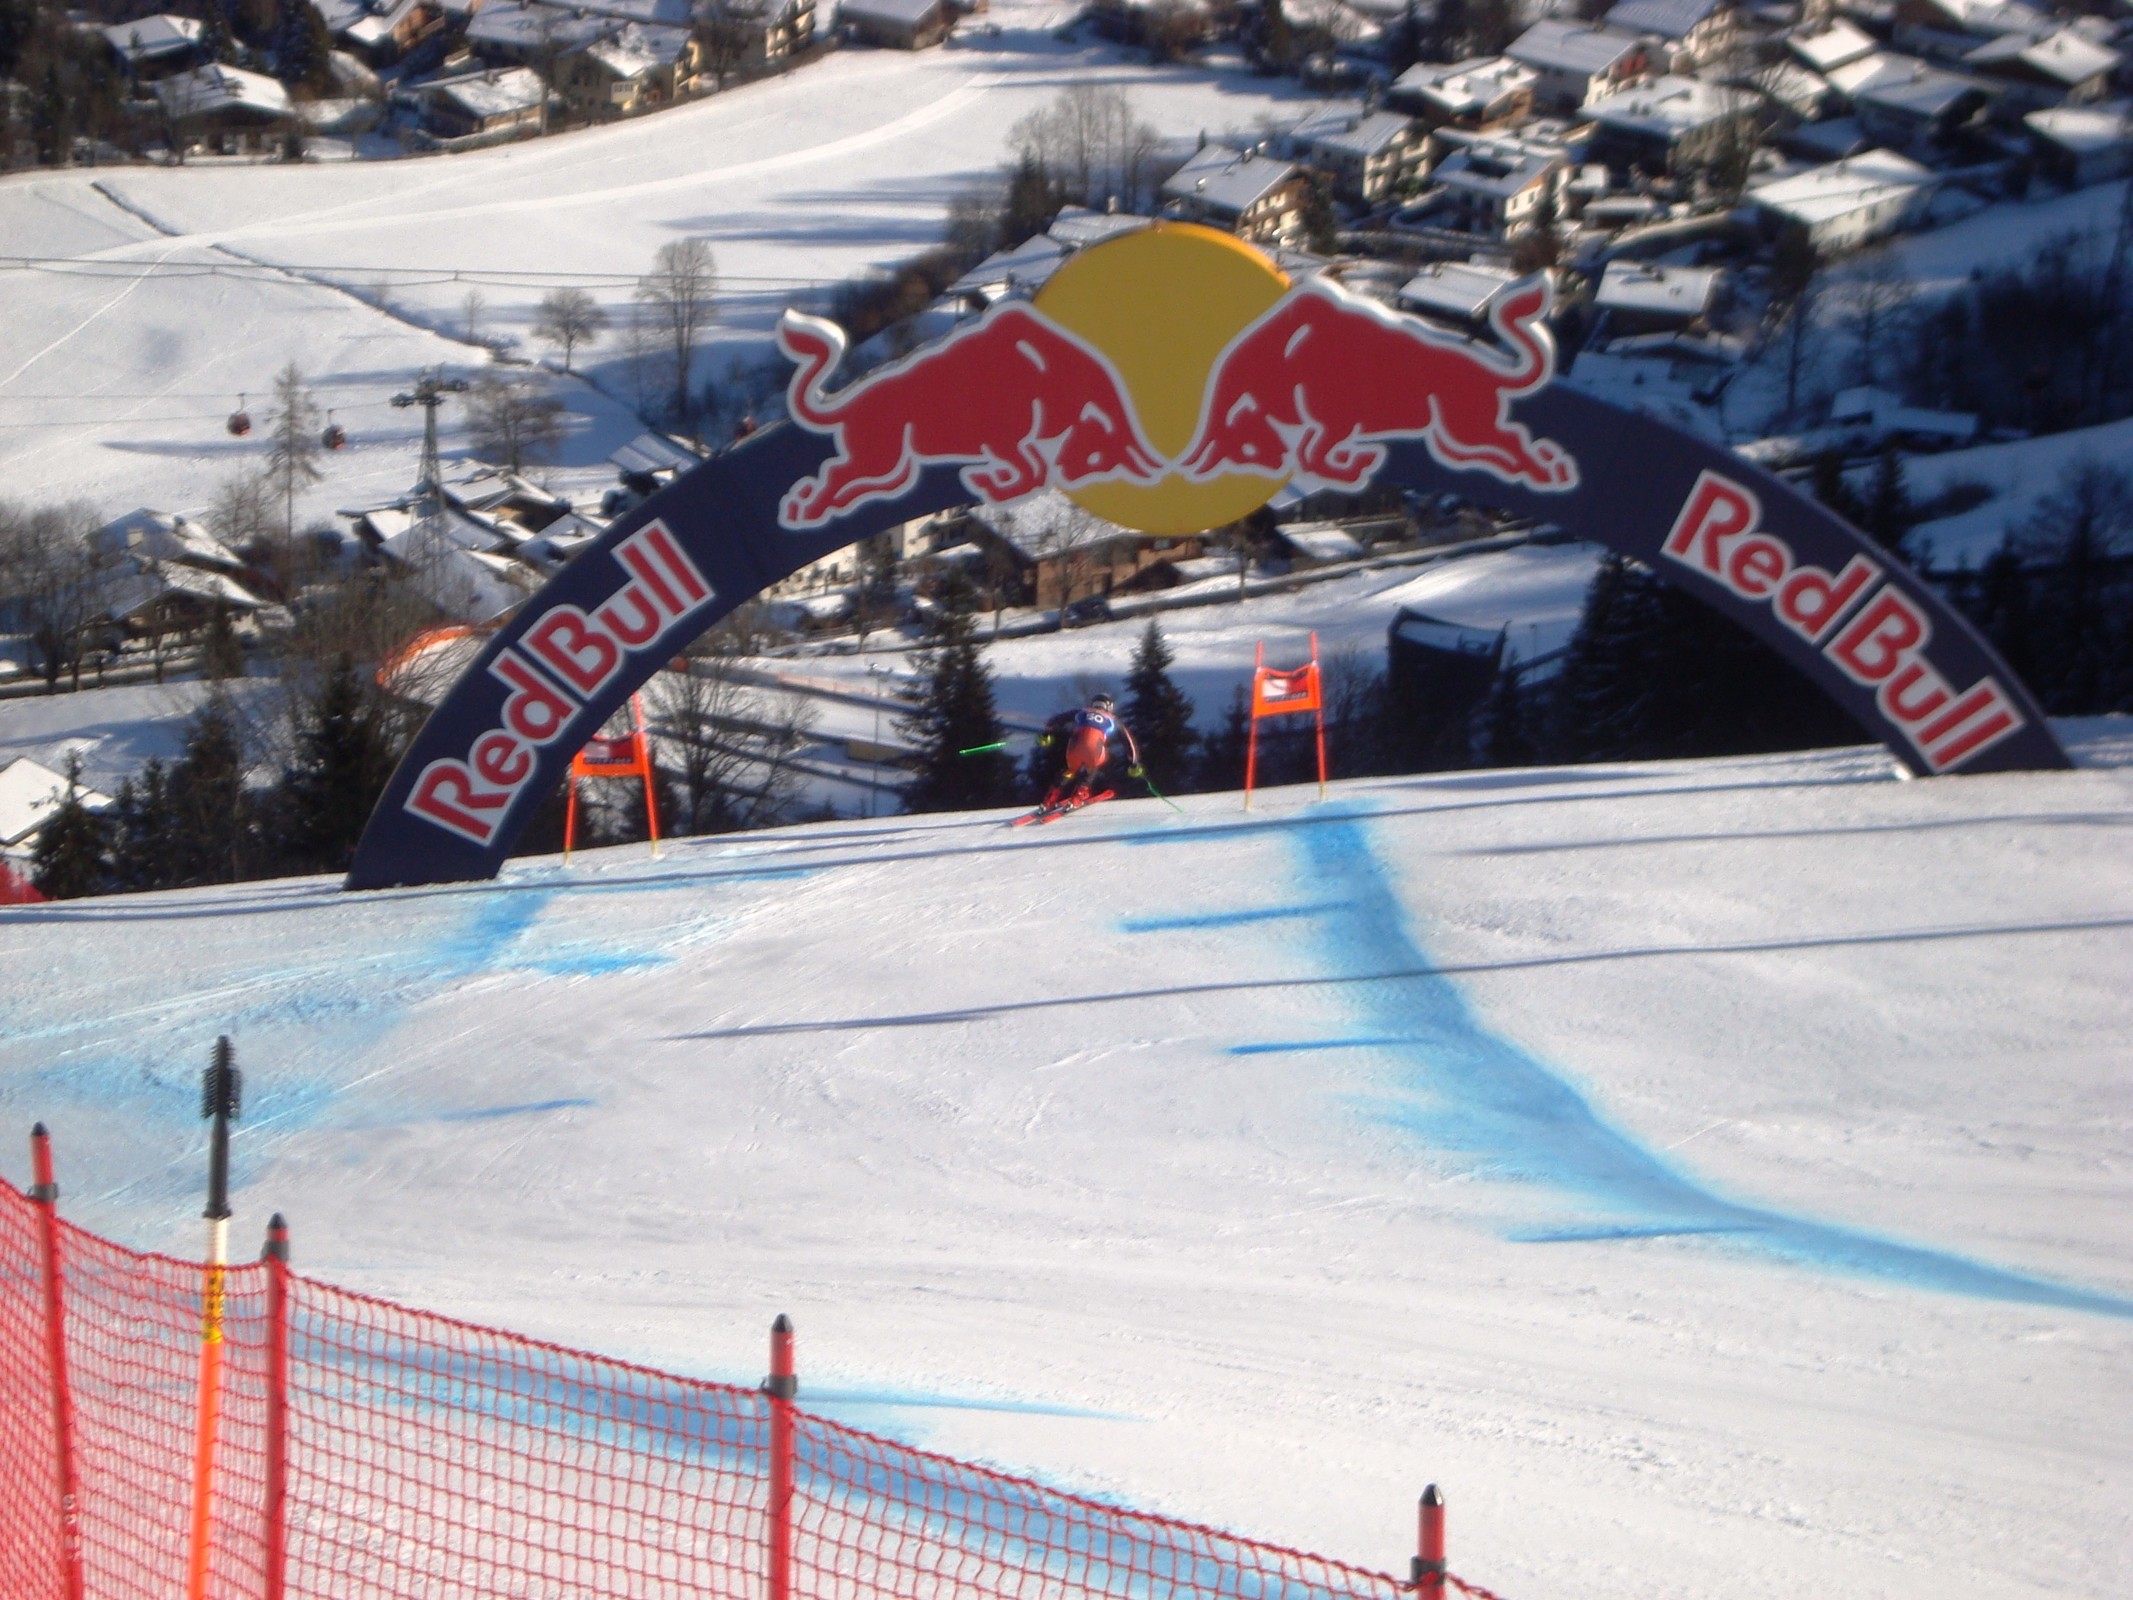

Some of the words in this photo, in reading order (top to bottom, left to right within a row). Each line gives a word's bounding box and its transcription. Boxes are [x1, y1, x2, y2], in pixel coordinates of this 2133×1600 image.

[405, 649, 580, 845] Red
[519, 519, 714, 698] Bull
[1661, 471, 1883, 644] Red
[1823, 584, 2024, 772] Bull
